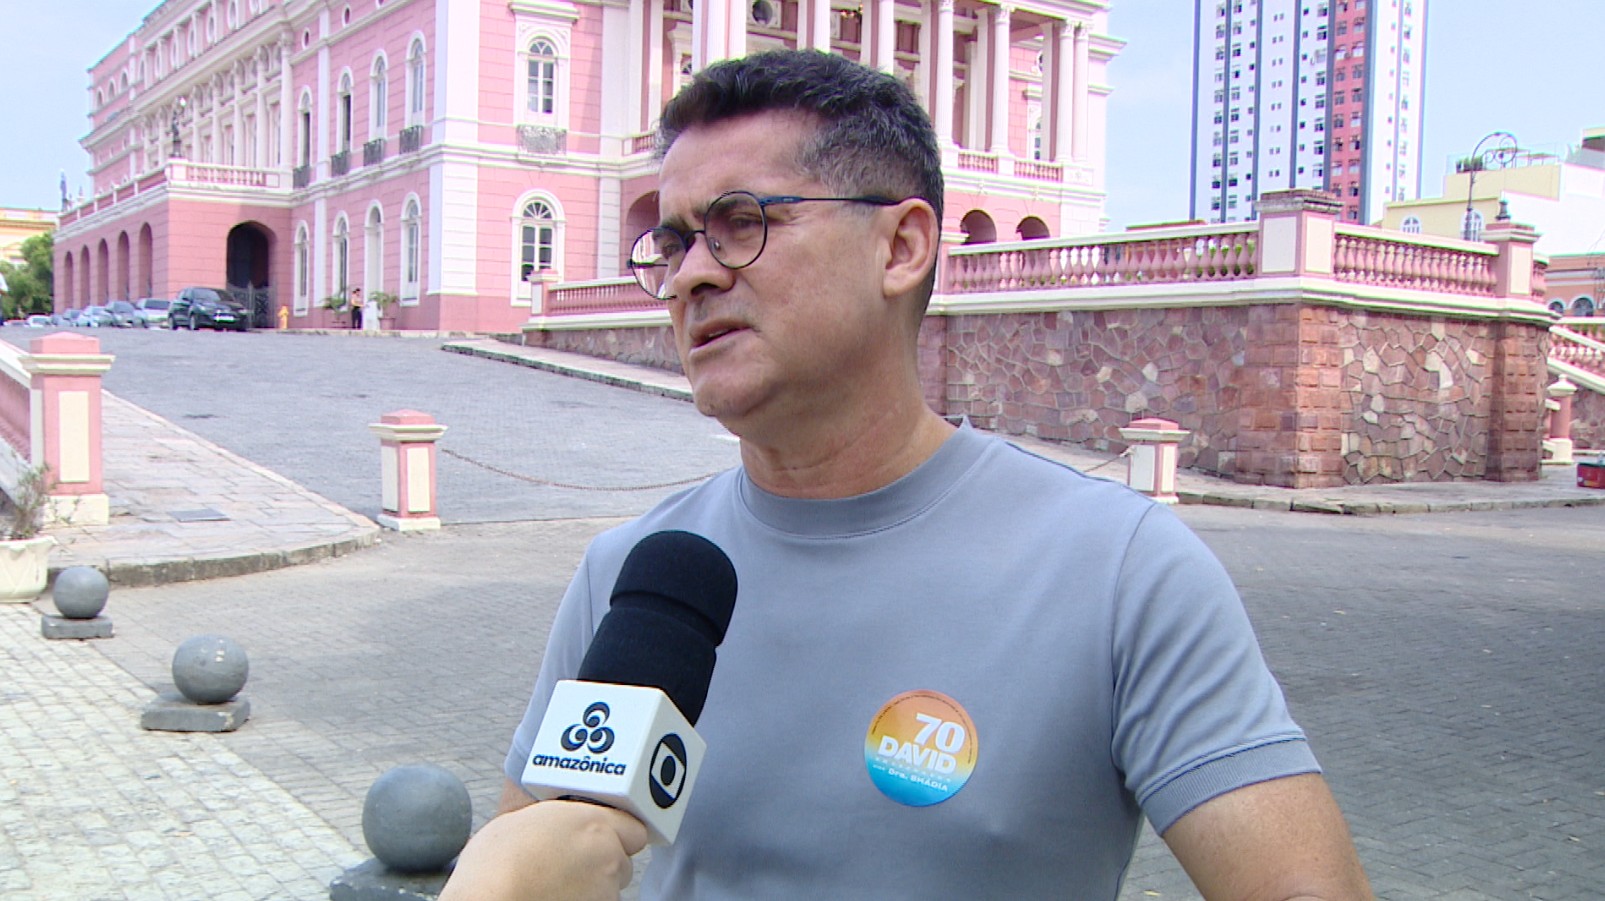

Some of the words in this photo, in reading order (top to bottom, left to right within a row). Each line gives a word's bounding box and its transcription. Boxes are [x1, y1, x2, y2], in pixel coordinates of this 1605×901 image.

[914, 712, 966, 754] 70
[532, 753, 627, 775] amazônica
[878, 735, 957, 775] DAVID
